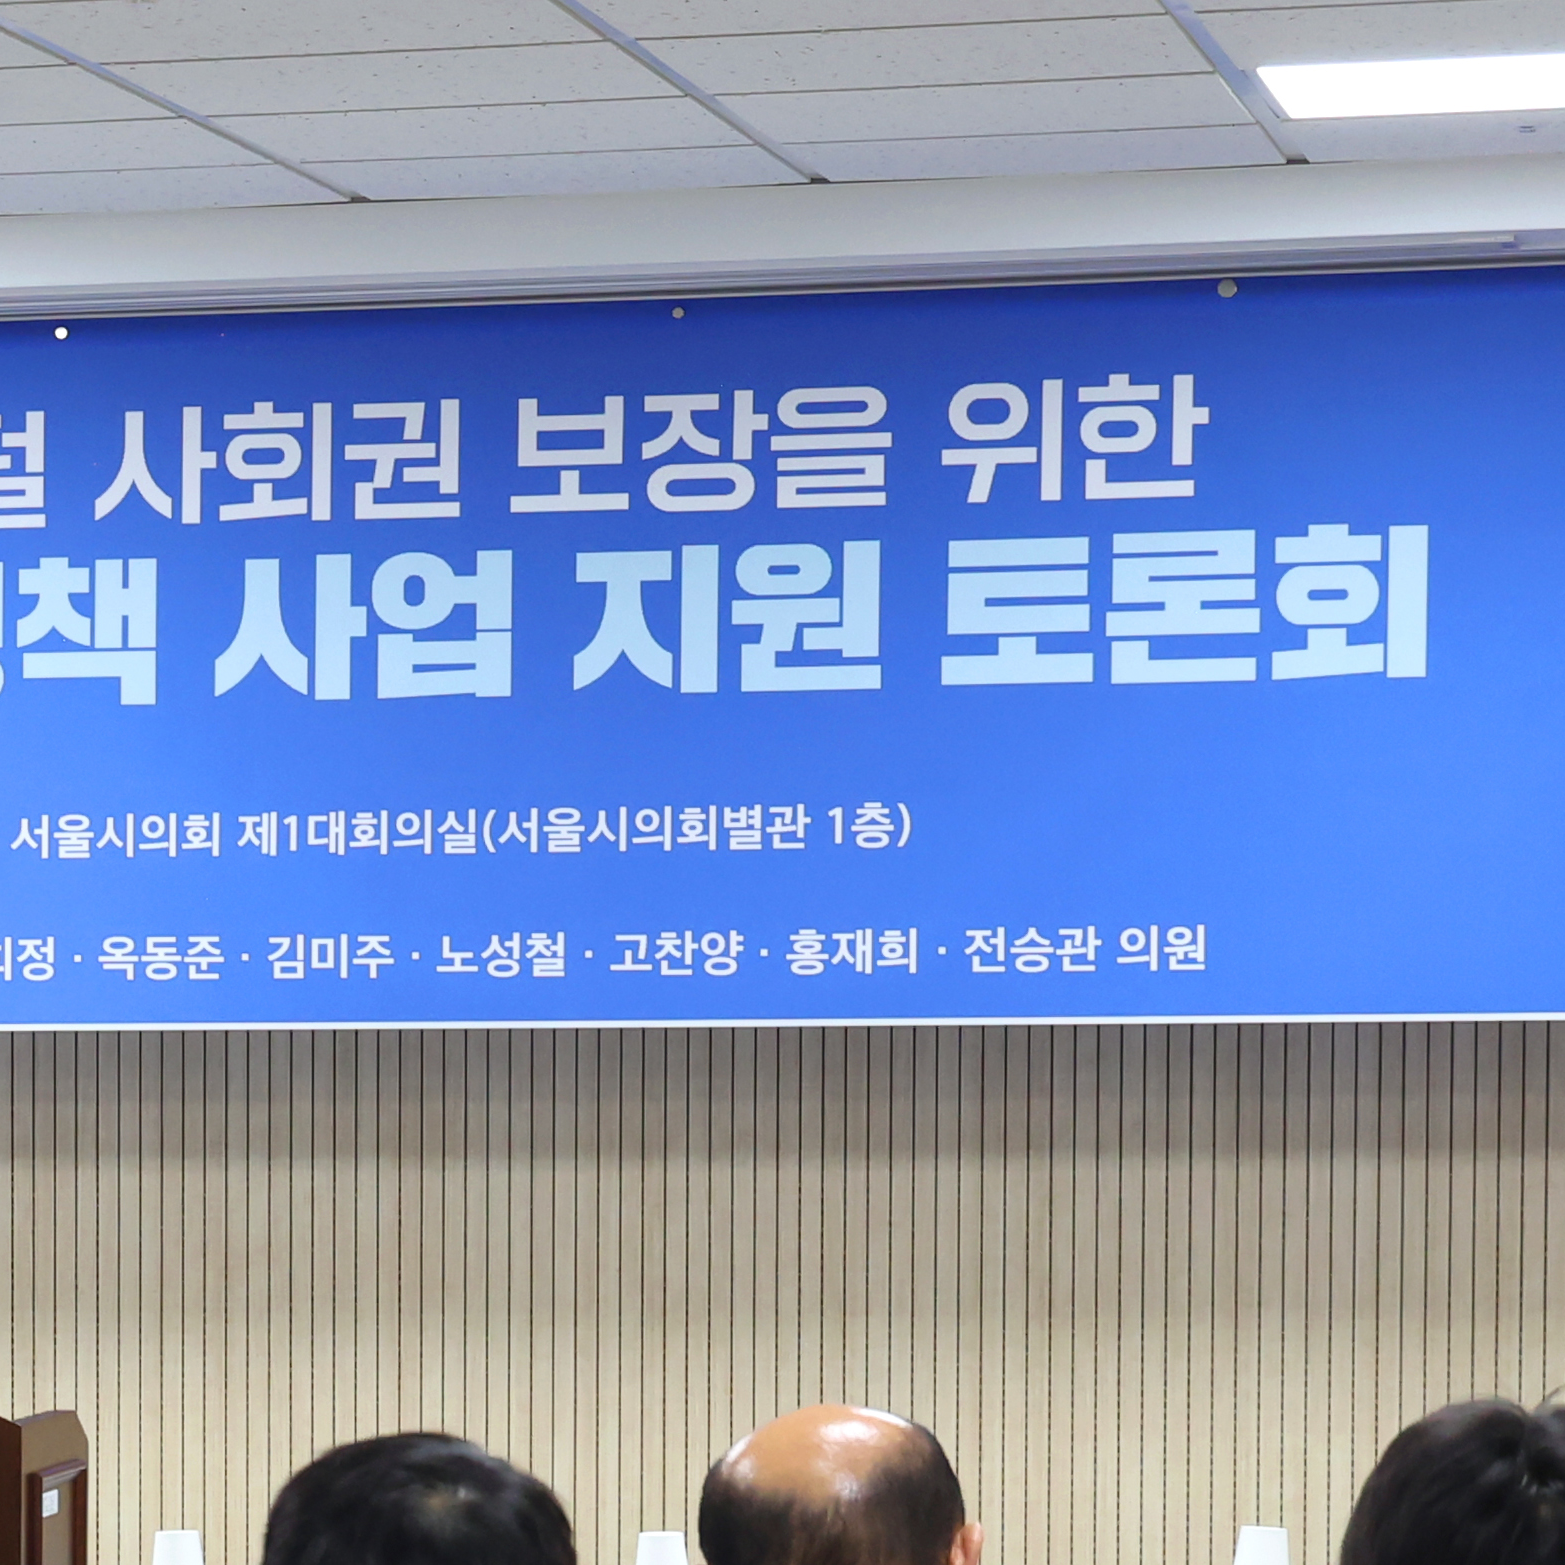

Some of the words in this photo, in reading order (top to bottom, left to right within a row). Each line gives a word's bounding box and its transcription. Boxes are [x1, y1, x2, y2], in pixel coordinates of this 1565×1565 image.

[94, 399, 460, 524] 사회권
[510, 387, 892, 513] 보장을
[941, 374, 1209, 503] 위한
[214, 550, 512, 700] 사업
[573, 541, 881, 693] 지원
[941, 524, 1428, 685] 토론회
[10, 812, 220, 859] 서울시의회
[237, 803, 812, 857] 제1대회의실(서울시의회별관
[828, 802, 911, 850] 1층)
[97, 935, 225, 981] 옥동준
[266, 932, 396, 980] 김미주
[436, 930, 566, 979] 노성철
[610, 929, 745, 976] 고찬양
[785, 927, 918, 976] 홍재희
[964, 924, 1102, 973] 전승관
[1116, 923, 1206, 972] 의원
